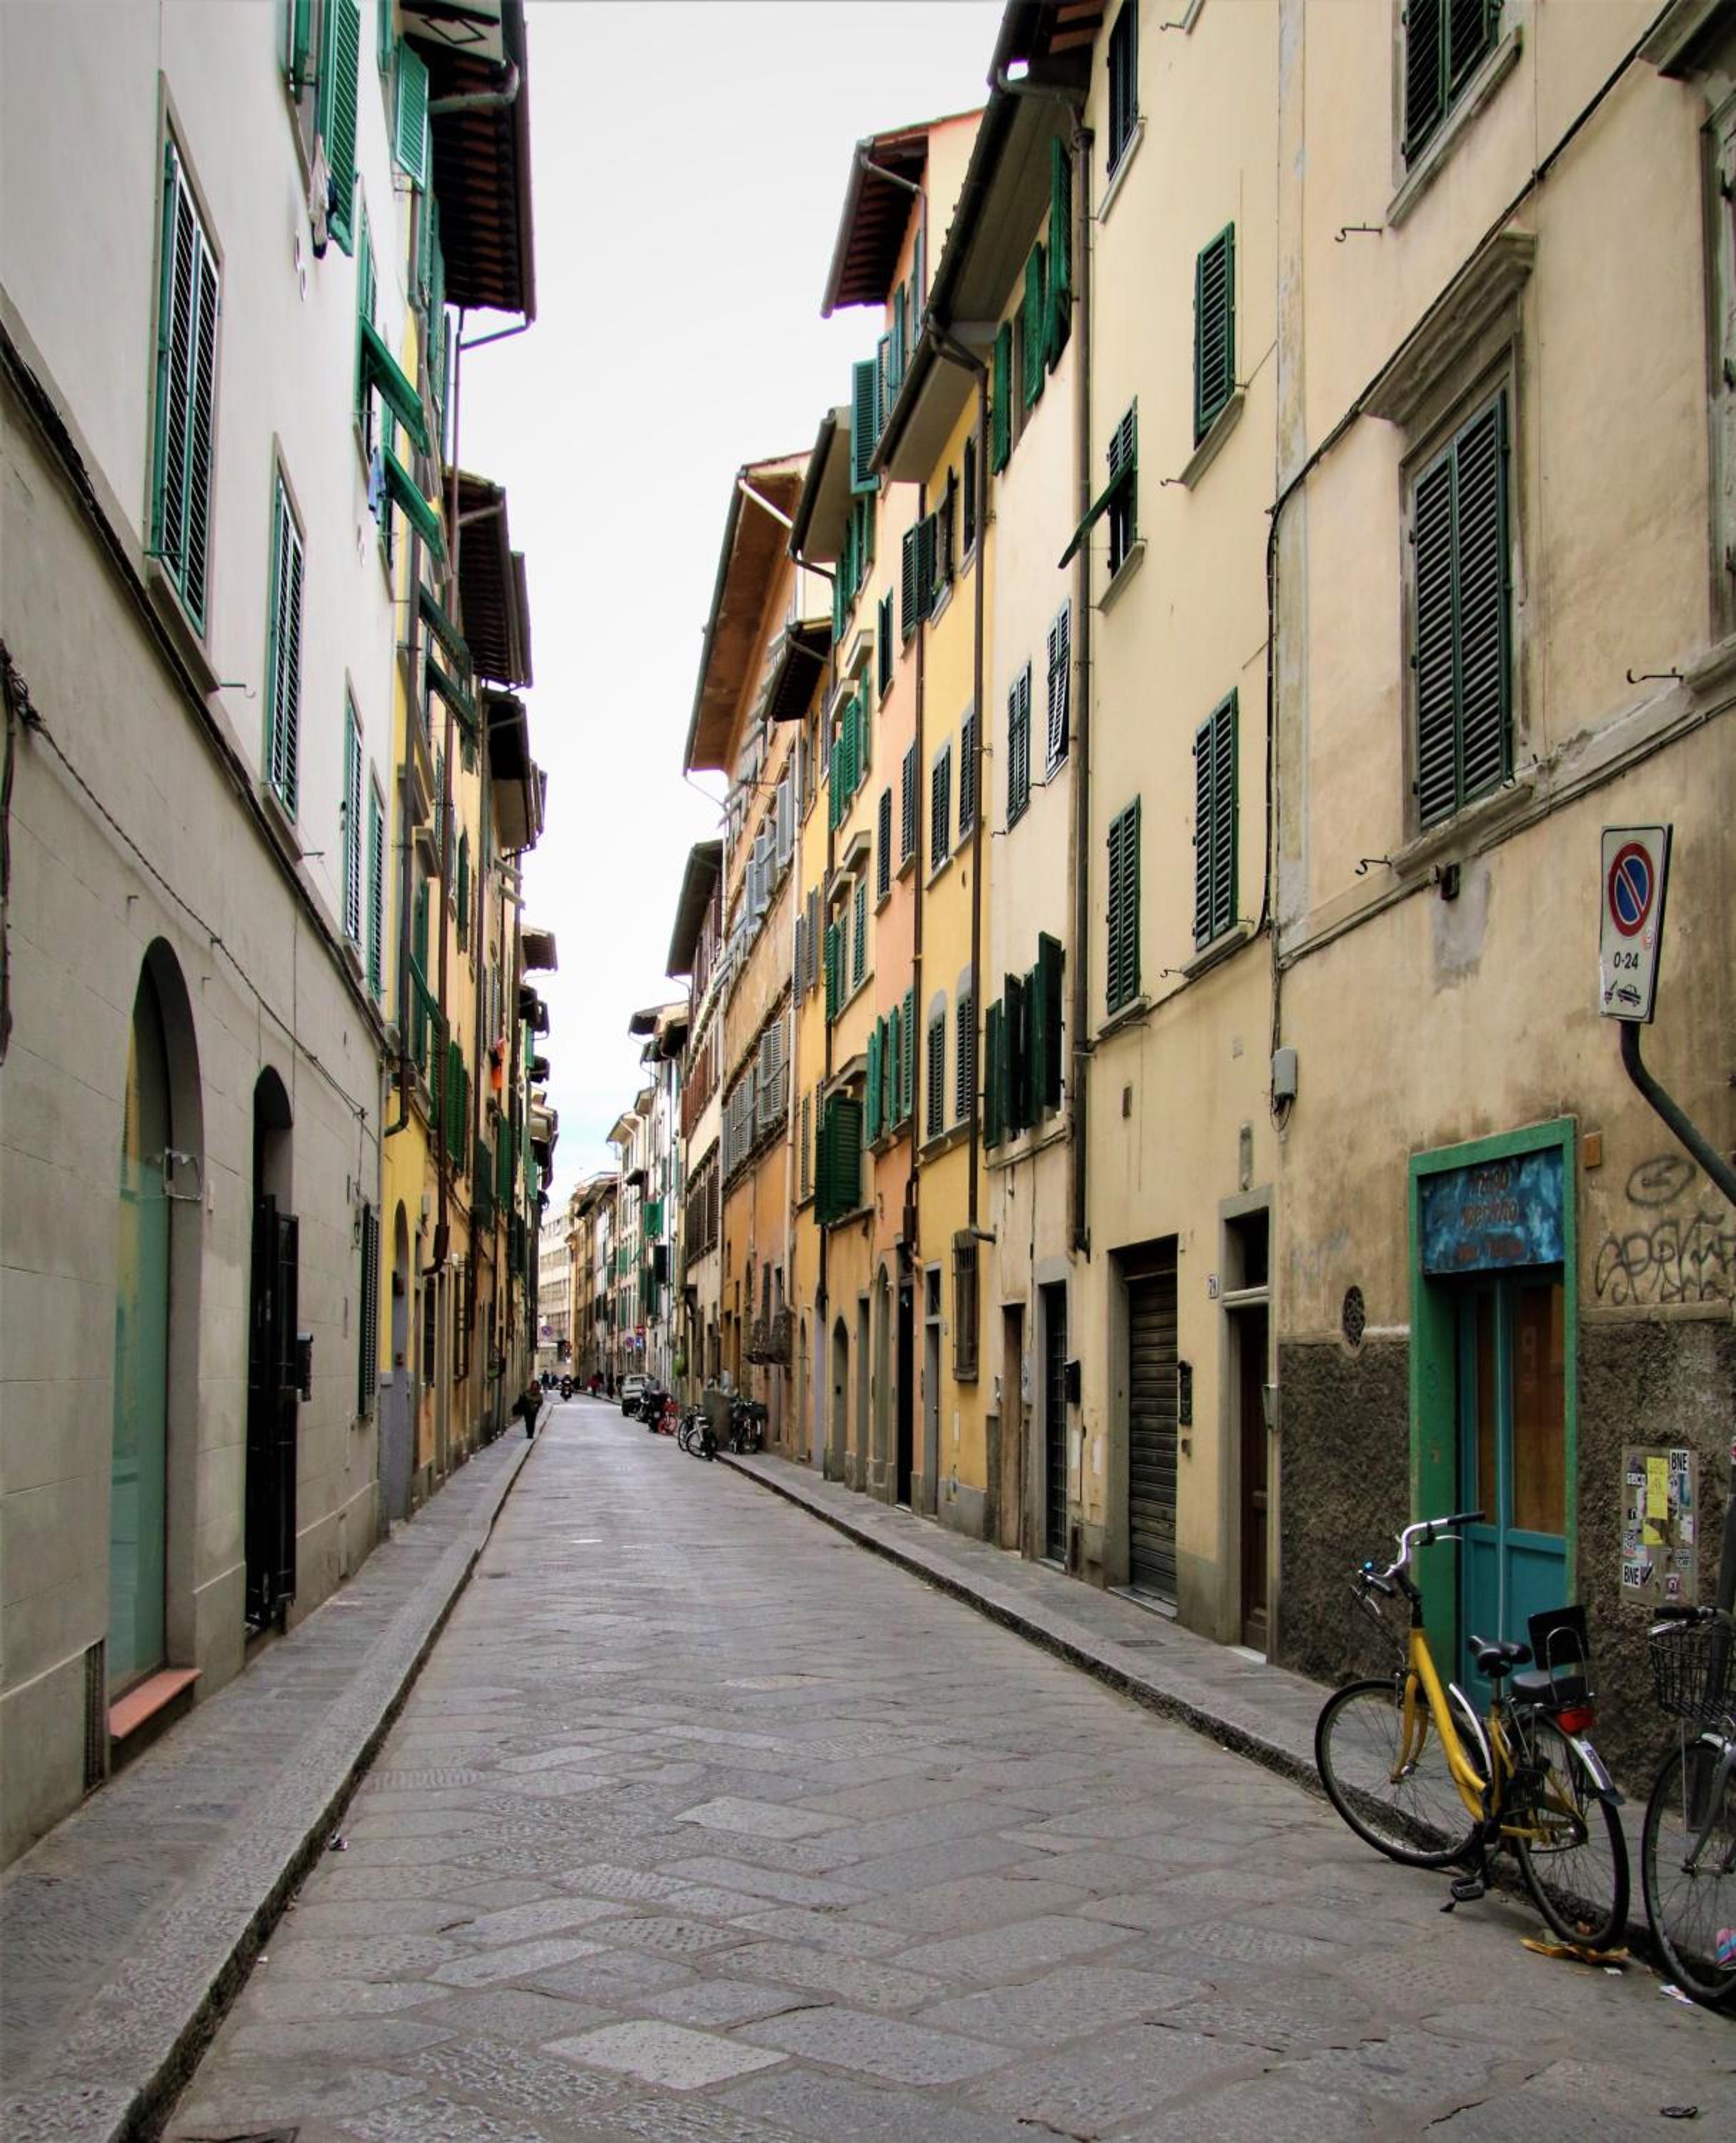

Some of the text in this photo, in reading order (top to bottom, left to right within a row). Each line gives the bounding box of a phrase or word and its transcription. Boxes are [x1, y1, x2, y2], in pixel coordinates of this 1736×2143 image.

[1614, 951, 1639, 970] 0-24
[1672, 1452, 1687, 1472] BNE
[1624, 1565, 1640, 1585] BNE
